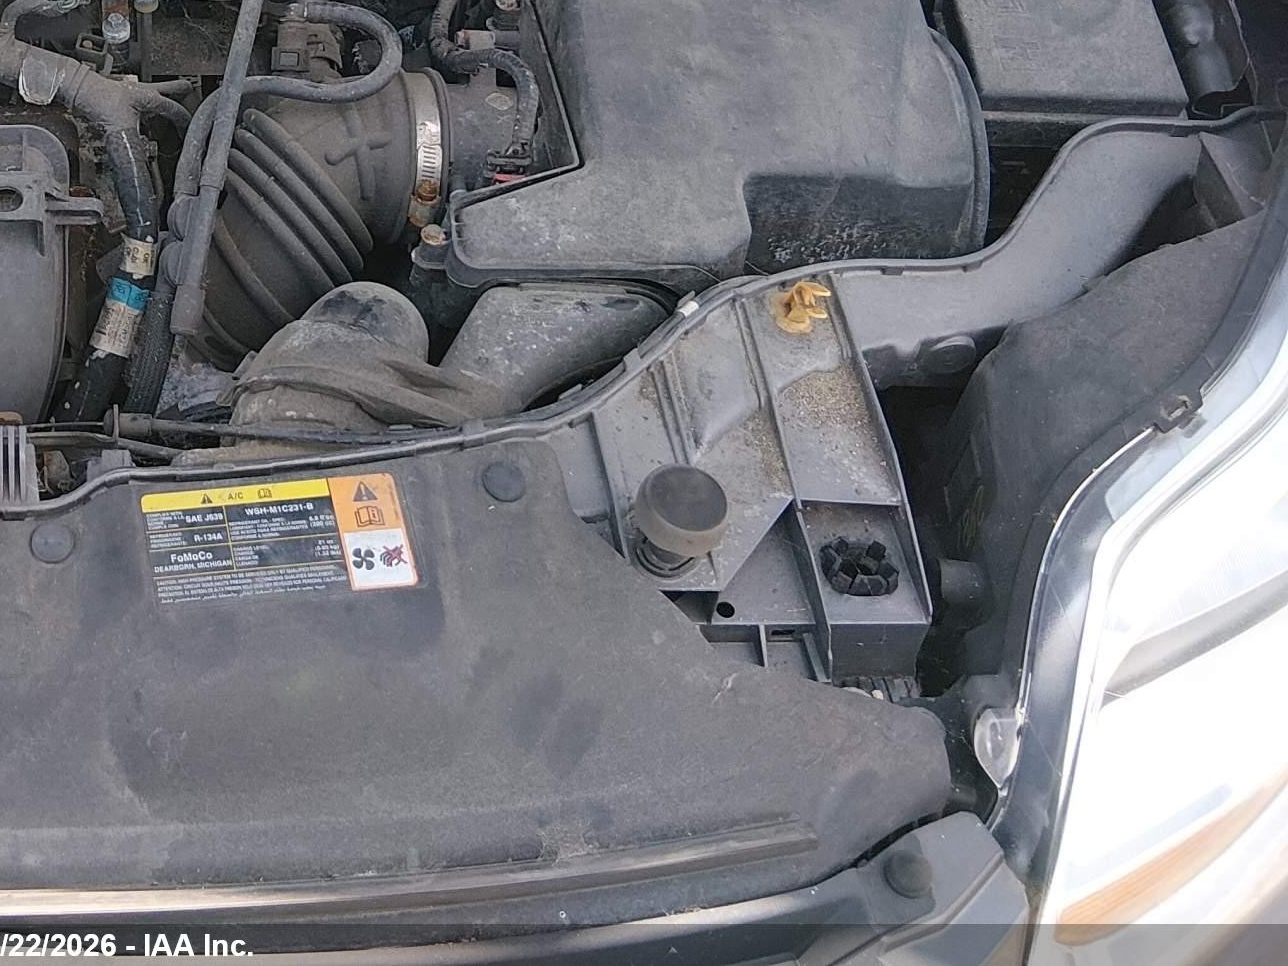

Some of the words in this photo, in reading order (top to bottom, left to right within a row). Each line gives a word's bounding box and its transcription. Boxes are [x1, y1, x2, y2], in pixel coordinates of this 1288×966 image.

[227, 491, 243, 500] A/C
[185, 514, 203, 523] SAE
[193, 532, 223, 543] R-134A
[170, 551, 213, 563] FoMoCo
[197, 560, 233, 570] MICHIGAN
